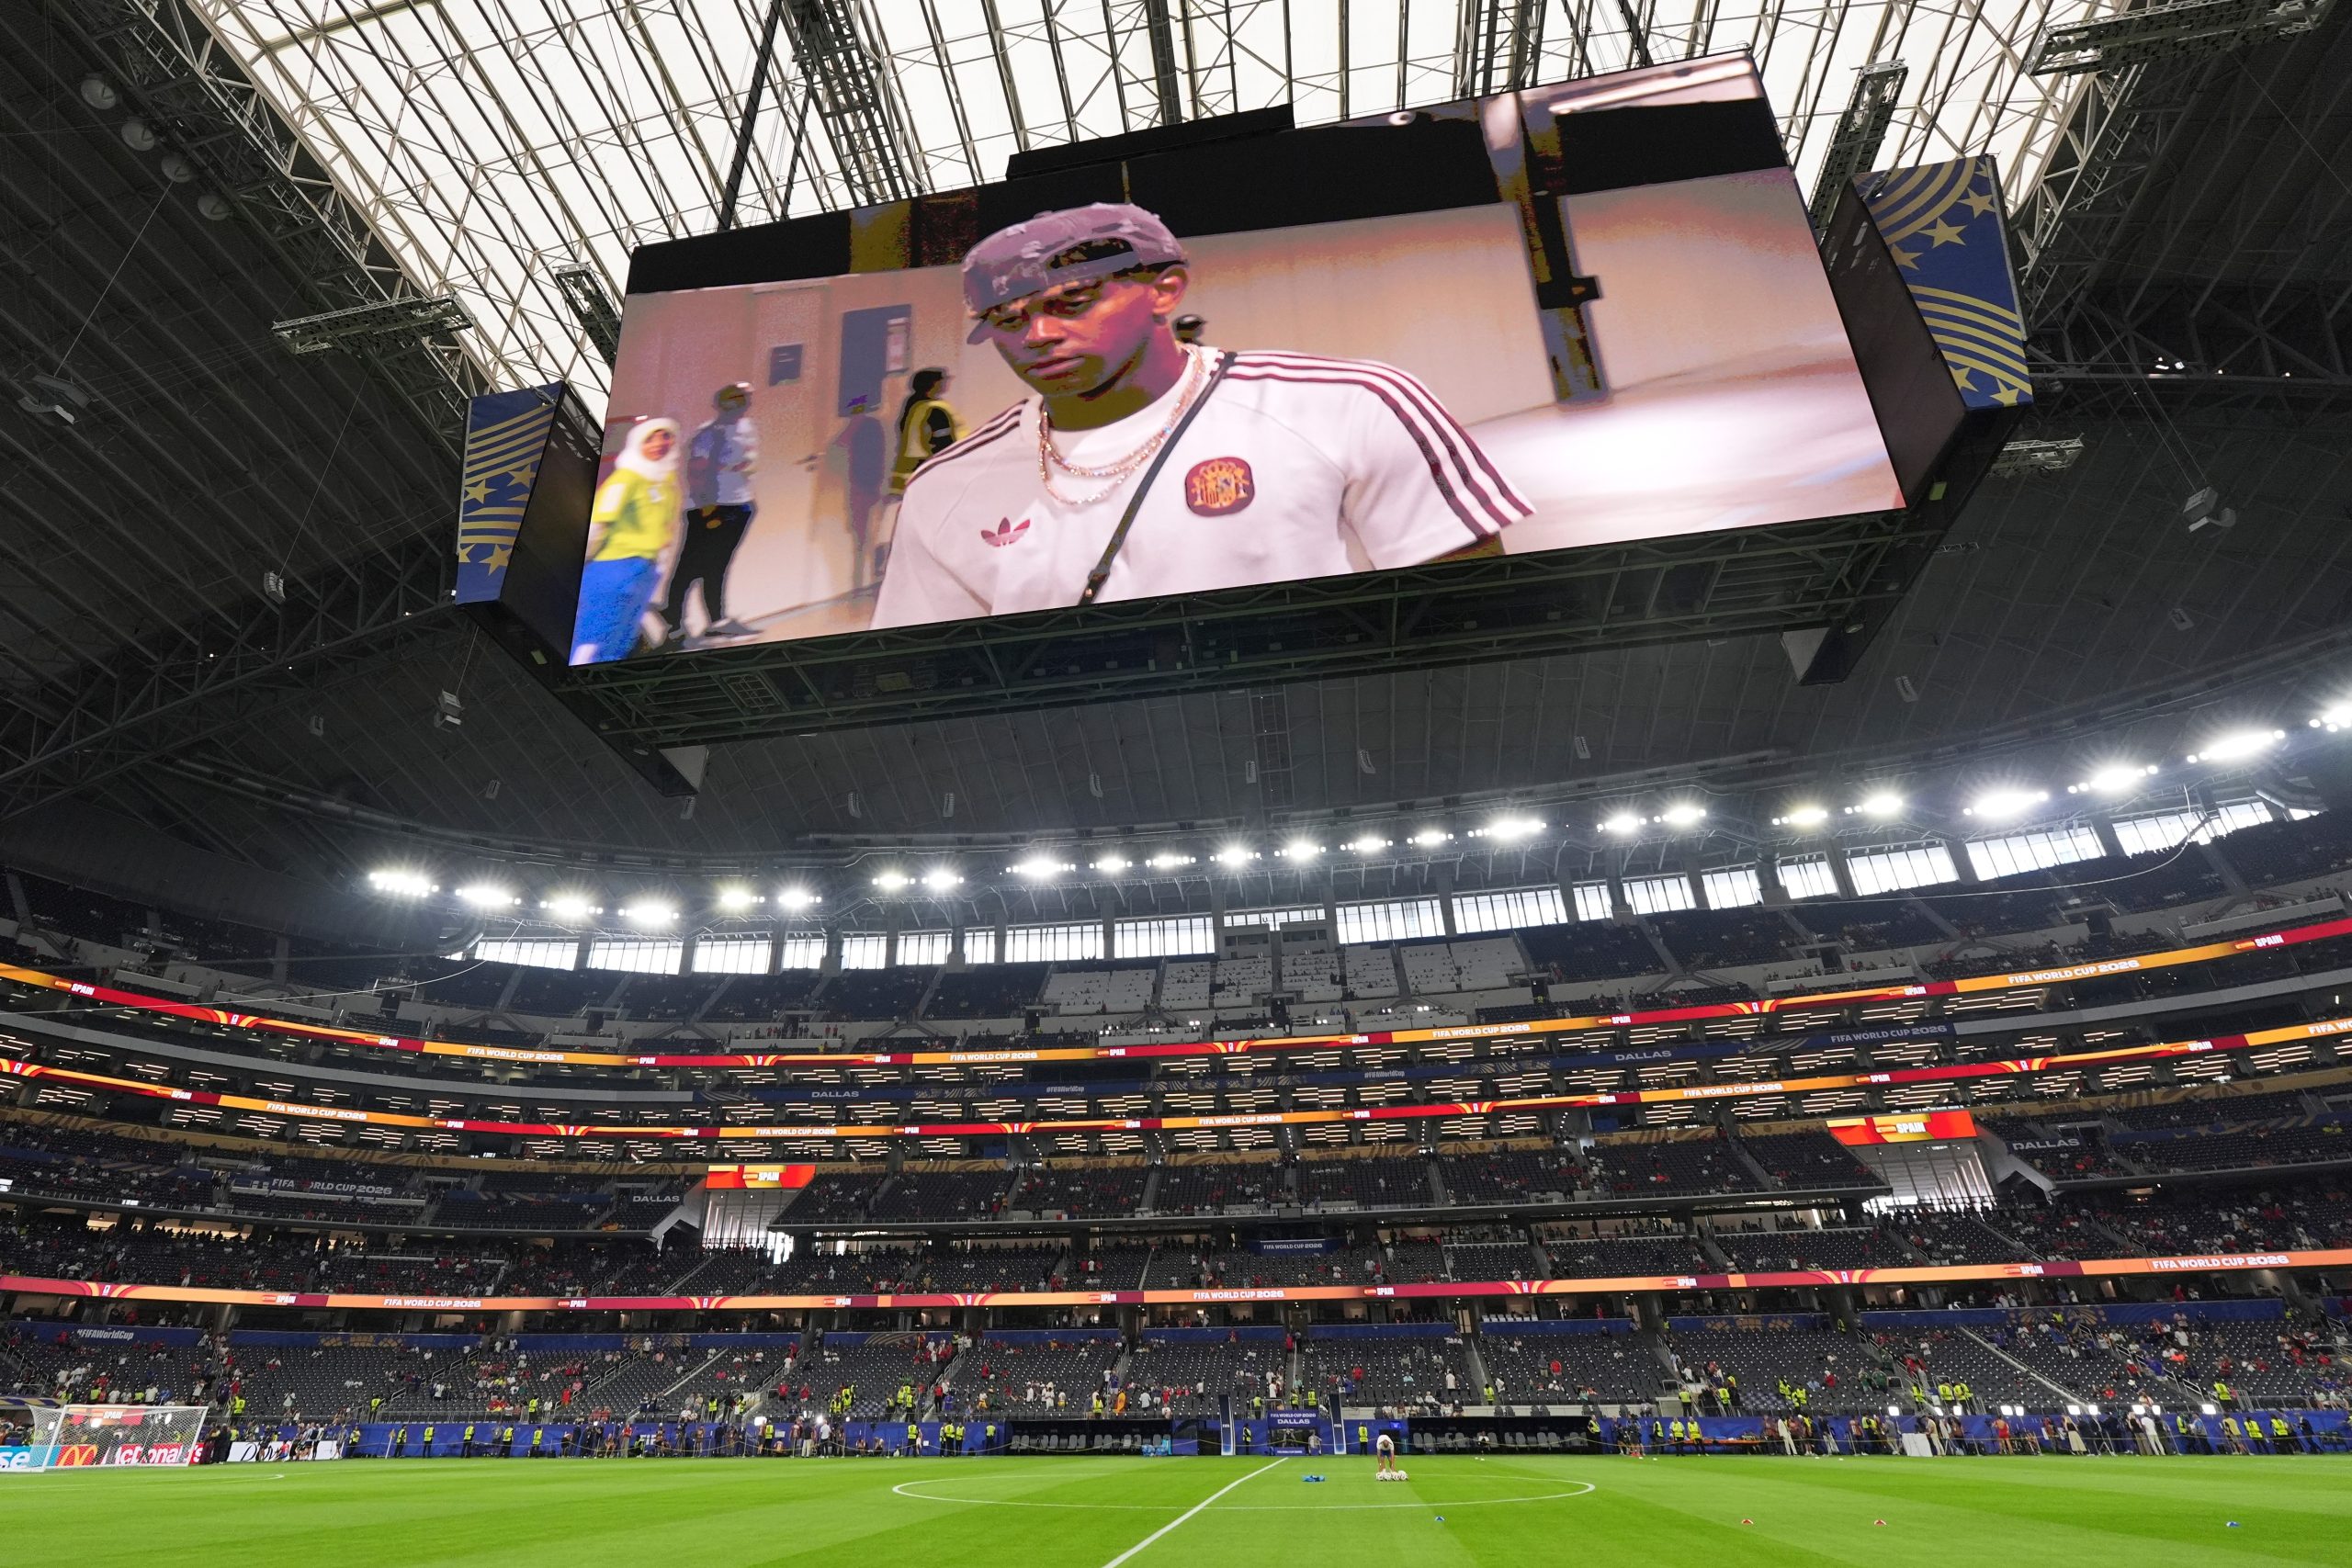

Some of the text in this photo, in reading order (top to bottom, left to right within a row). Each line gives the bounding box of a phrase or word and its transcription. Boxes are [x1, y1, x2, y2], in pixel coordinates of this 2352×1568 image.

[2255, 934, 2284, 947] SPAIN
[2008, 960, 2139, 984] FIFA WORLD CUP 2026
[72, 983, 95, 996] SPAIN
[1904, 986, 1927, 996] SPAIN
[1611, 1015, 1631, 1024] SPAIN
[2308, 1023, 2336, 1034] FIFA
[1830, 1025, 1948, 1043] FIFA WORLD CUP 2026
[379, 1037, 399, 1046] SPAIN
[2188, 1041, 2213, 1051] SPAIN
[467, 1047, 485, 1055] FIFA
[487, 1049, 516, 1058] WORLD
[1110, 1048, 1125, 1056] SPAIN
[1615, 1050, 1672, 1061] DALLAS
[1870, 1074, 1891, 1082] SPAIN
[1702, 1087, 1733, 1095] WORLD
[1752, 1083, 1783, 1091] 2026
[171, 1090, 192, 1100] SPAIN
[267, 1103, 285, 1111] FIFA
[287, 1106, 318, 1115] WORLD
[337, 1111, 367, 1120] 2026
[1895, 1122, 1927, 1134] SPAIN
[2013, 1138, 2080, 1150] DALLAS
[759, 1171, 780, 1181] SPAIN
[272, 1179, 392, 1194] FIFA RLD CUP 2026
[2153, 1255, 2290, 1269] FIFA WORLD CUP 2026
[2020, 1265, 2044, 1274] SPAIN
[1677, 1278, 1697, 1286] SPAIN
[1211, 1291, 1238, 1299] WORLD
[1376, 1287, 1394, 1295] SPAIN
[276, 1295, 296, 1303] SPAIN
